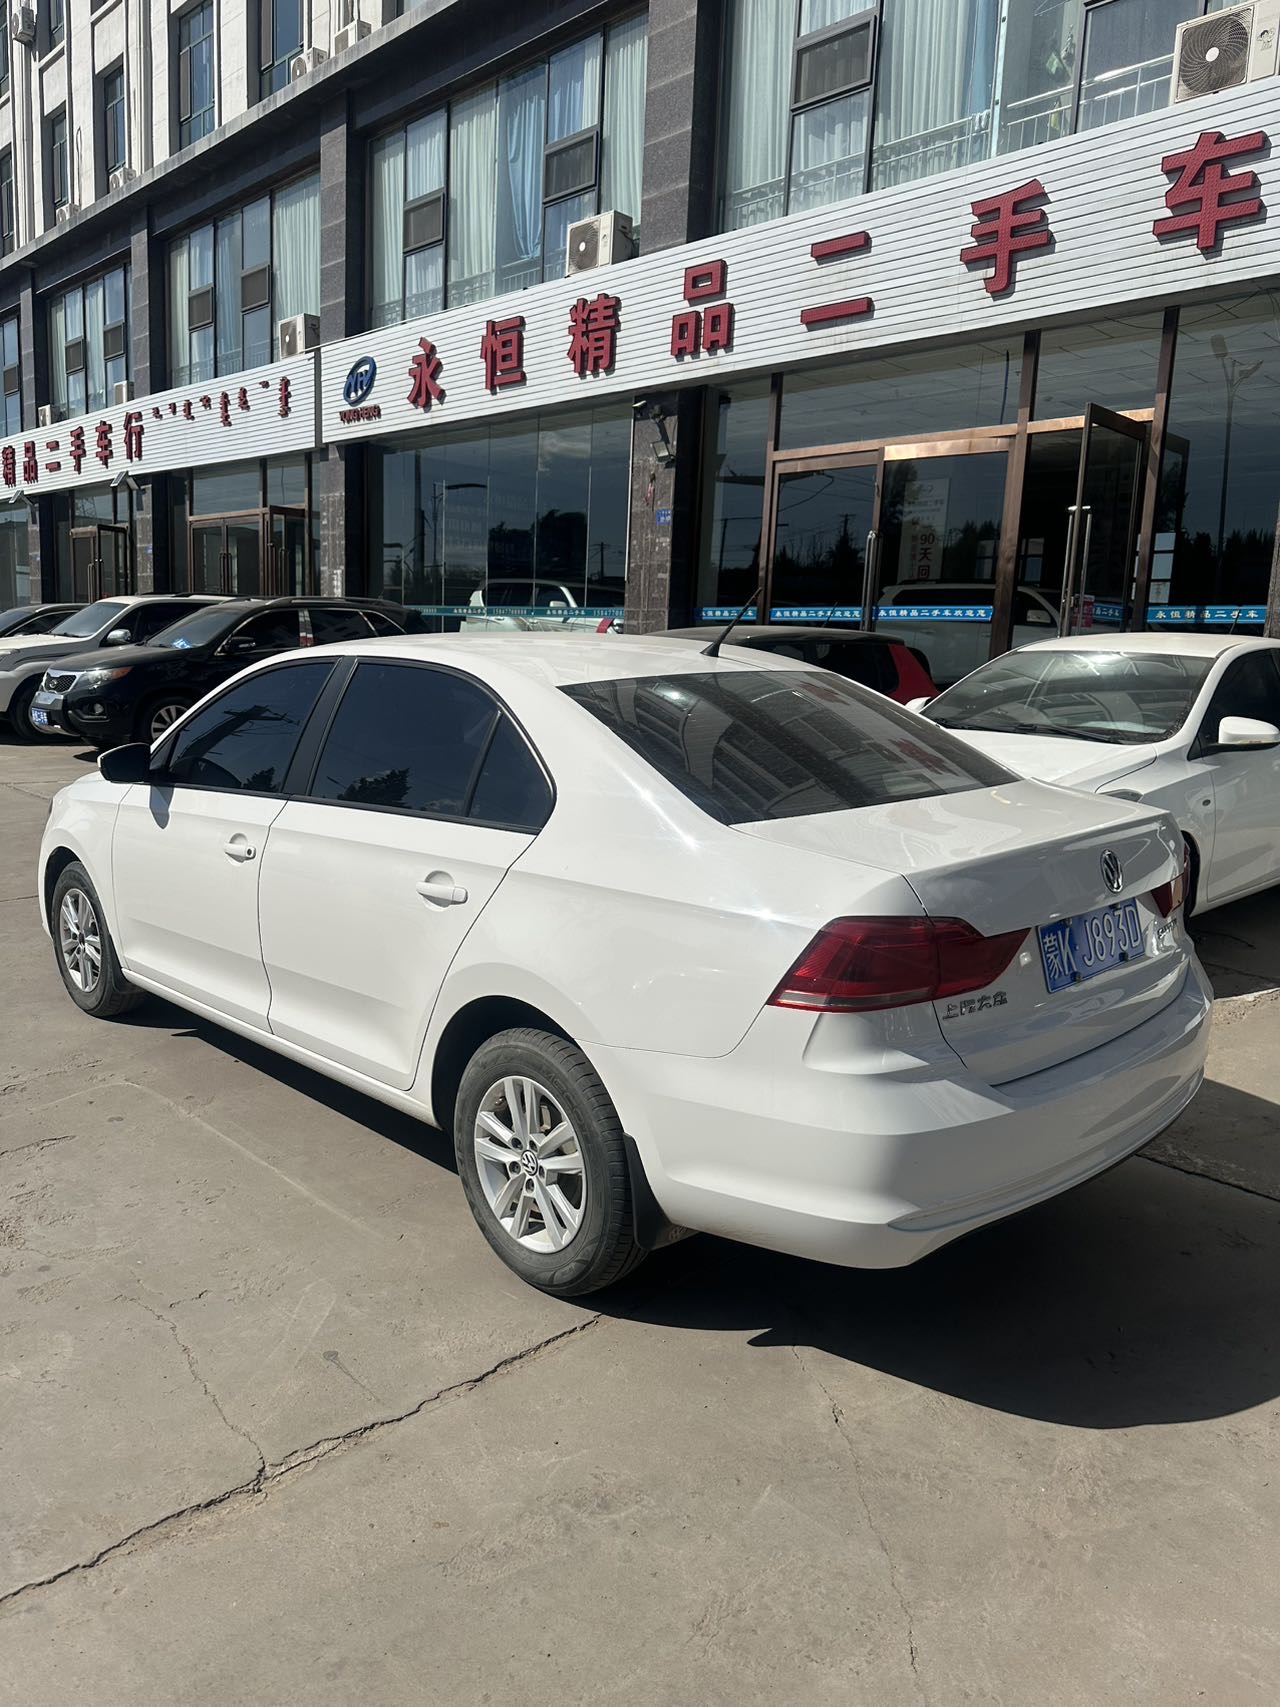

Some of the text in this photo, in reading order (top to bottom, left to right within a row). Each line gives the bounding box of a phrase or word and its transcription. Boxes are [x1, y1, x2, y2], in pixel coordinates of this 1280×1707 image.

[408, 130, 1268, 411] 永恒精品二手车
[2, 411, 145, 488] 精品二手车行
